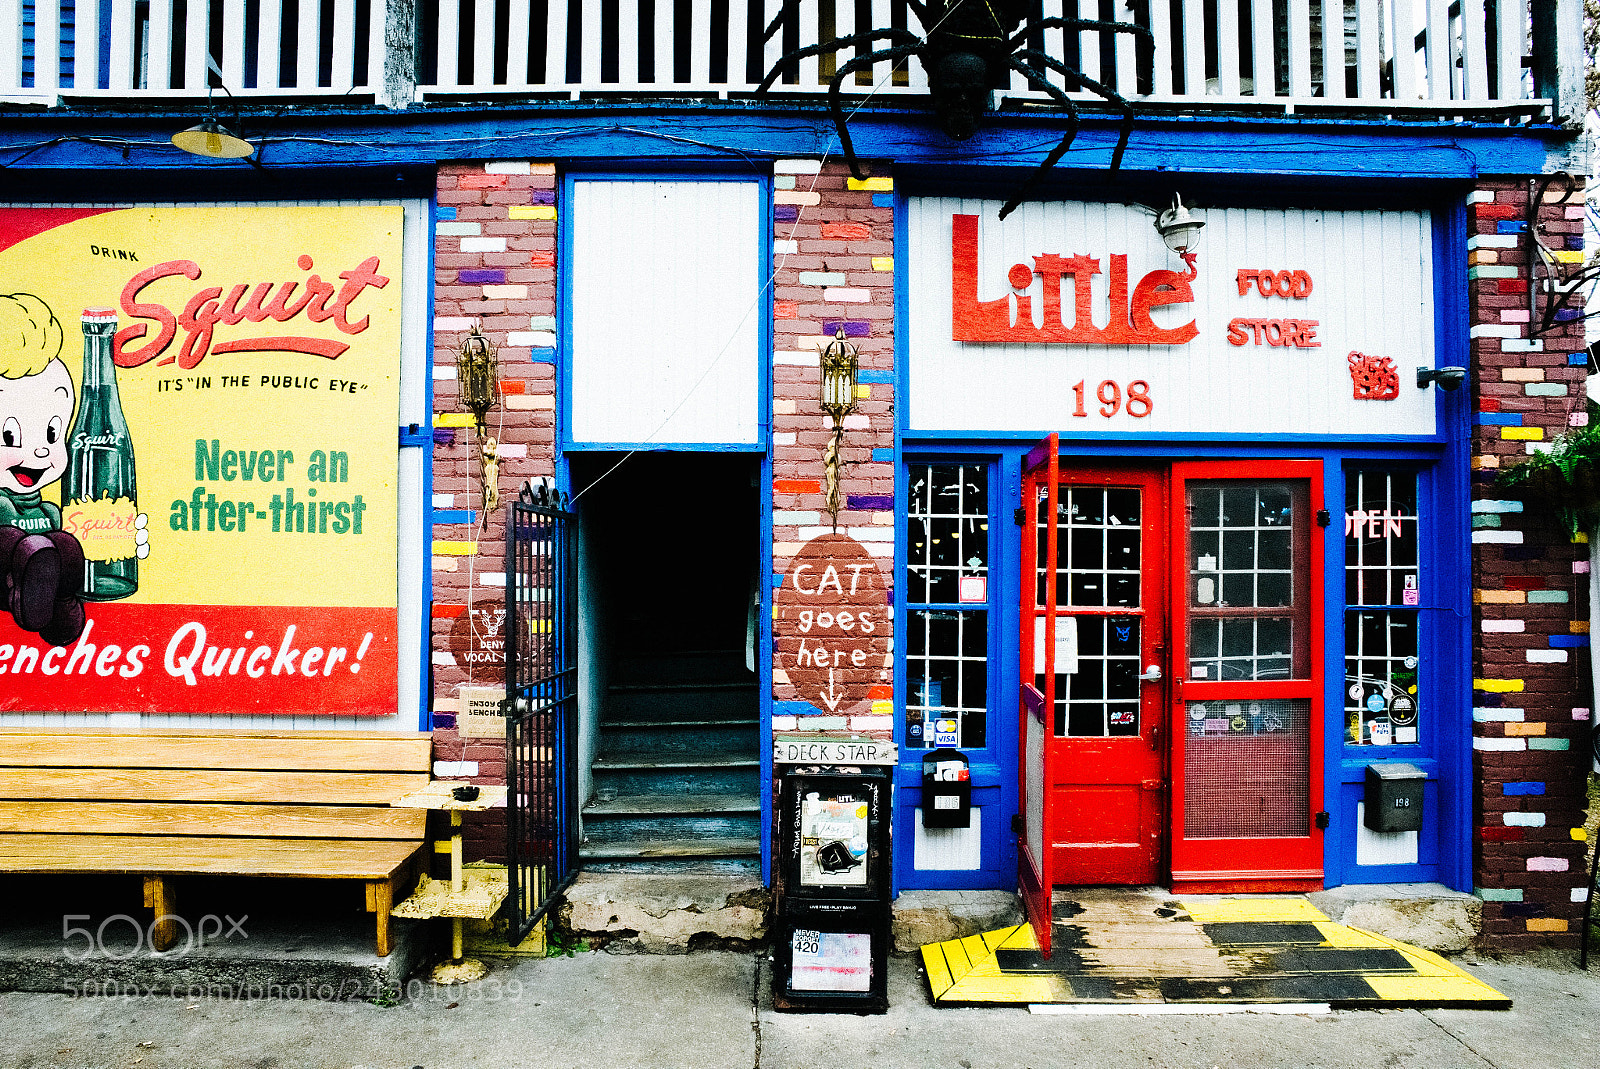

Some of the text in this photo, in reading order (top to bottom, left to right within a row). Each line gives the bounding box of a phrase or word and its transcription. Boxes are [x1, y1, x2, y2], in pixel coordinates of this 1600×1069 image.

[90, 245, 139, 262] DRINK
[952, 214, 1199, 344] Little
[1238, 268, 1313, 298] FOOD
[113, 254, 390, 370] Squirt
[1227, 317, 1321, 347] STORE
[158, 379, 182, 393] IT'S
[222, 376, 250, 389] THE
[261, 376, 318, 390] PUBLIC
[1071, 379, 1153, 418] 198
[71, 430, 126, 450] Squirt
[195, 439, 348, 482] Never an
[11, 517, 51, 531] SQUIRT
[170, 487, 366, 535] after-thirst
[63, 511, 135, 540] Squirt
[793, 564, 875, 596] CAT
[799, 610, 875, 633] goes
[164, 622, 373, 686] Quicker!
[481, 640, 505, 649] DENY
[797, 639, 867, 668] here
[788, 744, 877, 760] DECK STAR
[938, 735, 956, 743] VISA
[1395, 797, 1410, 807] 198
[795, 929, 820, 938] NEVER
[795, 941, 819, 954] 420
